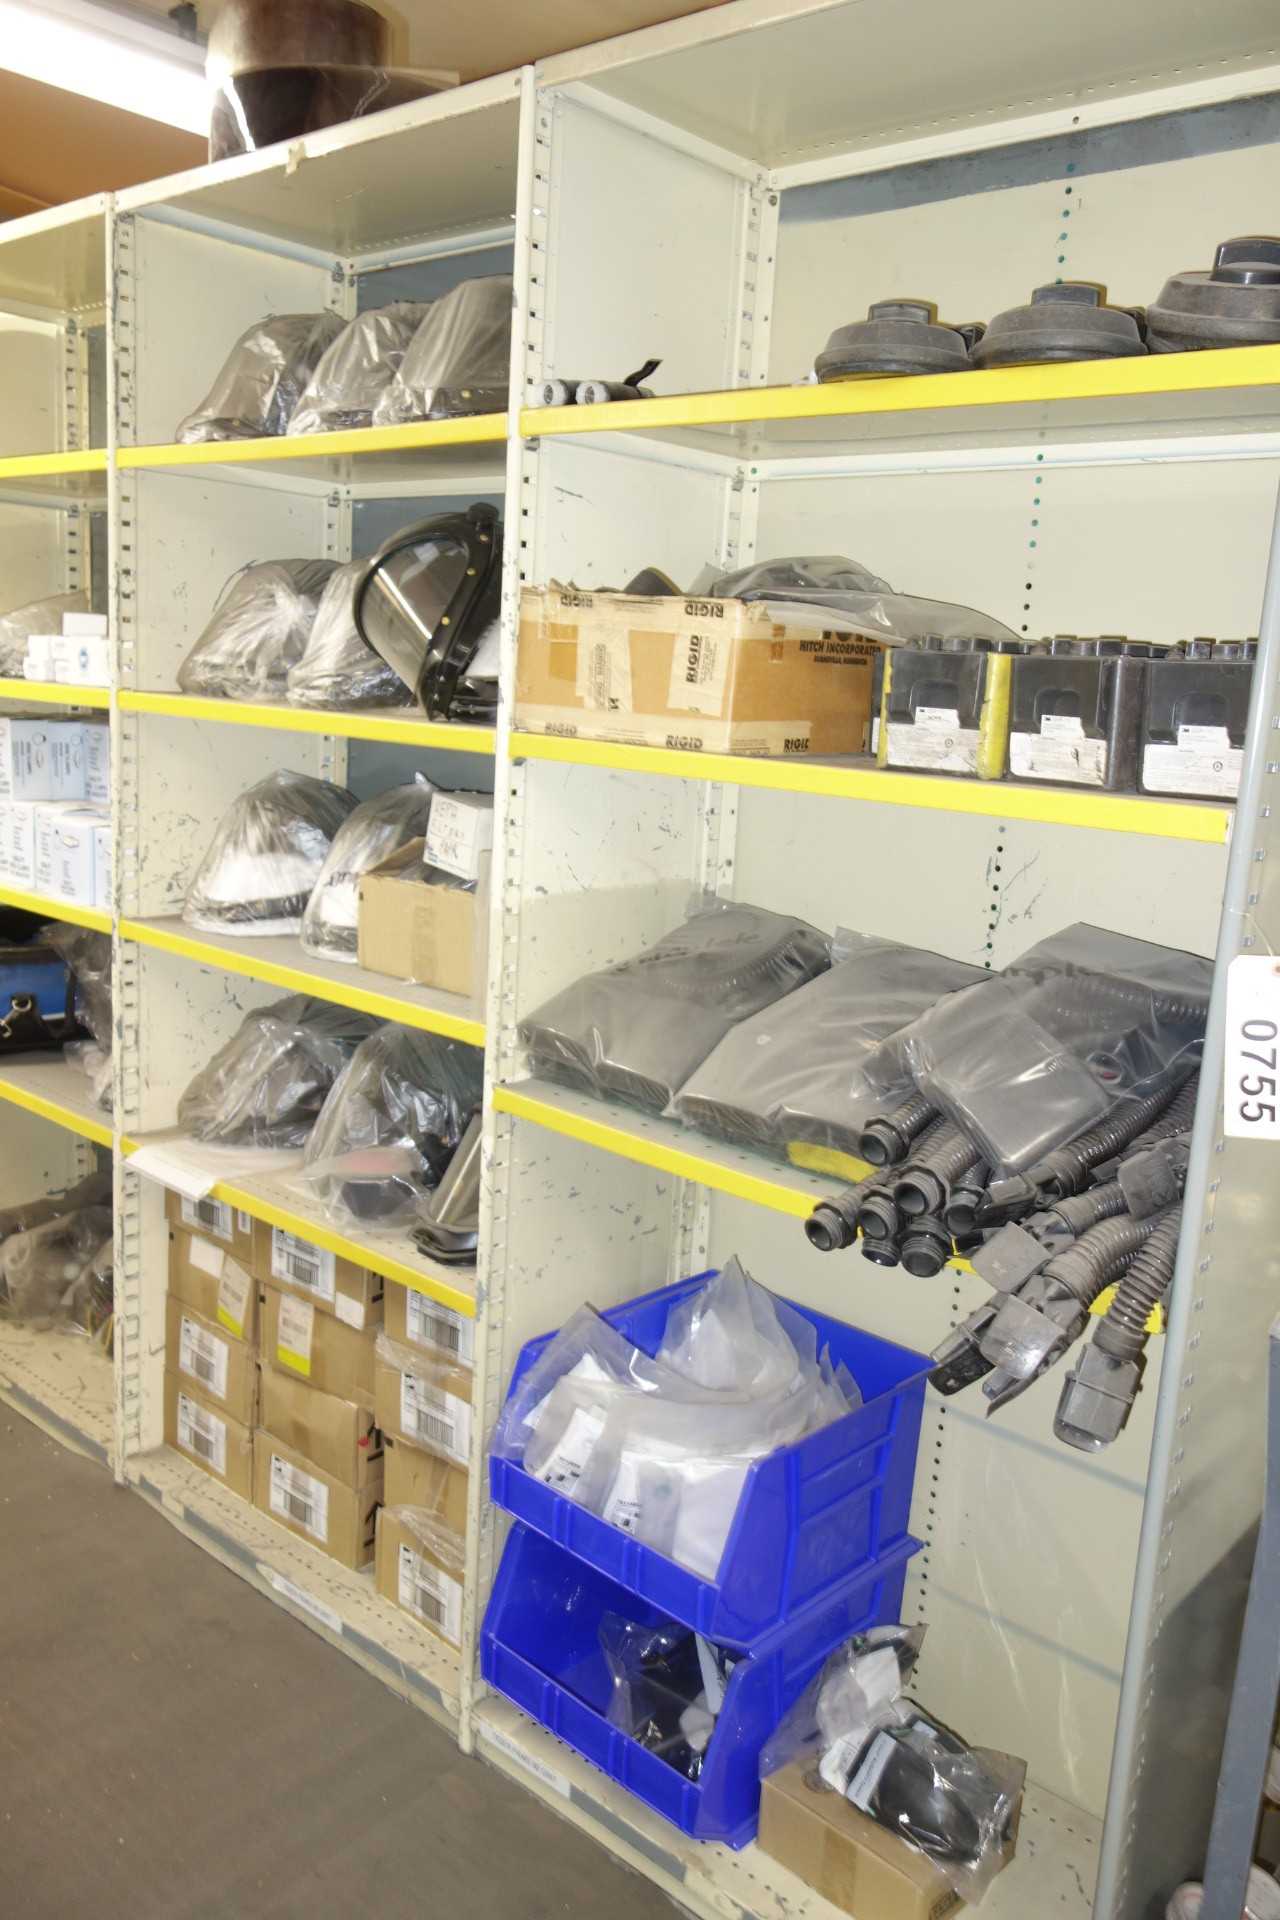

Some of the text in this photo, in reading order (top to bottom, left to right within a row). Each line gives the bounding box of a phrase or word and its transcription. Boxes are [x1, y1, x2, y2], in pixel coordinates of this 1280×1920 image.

[684, 603, 724, 618] RIGID
[685, 634, 700, 684] RIGID
[665, 735, 703, 750] RIGID
[1240, 1019, 1278, 1123] 0755
